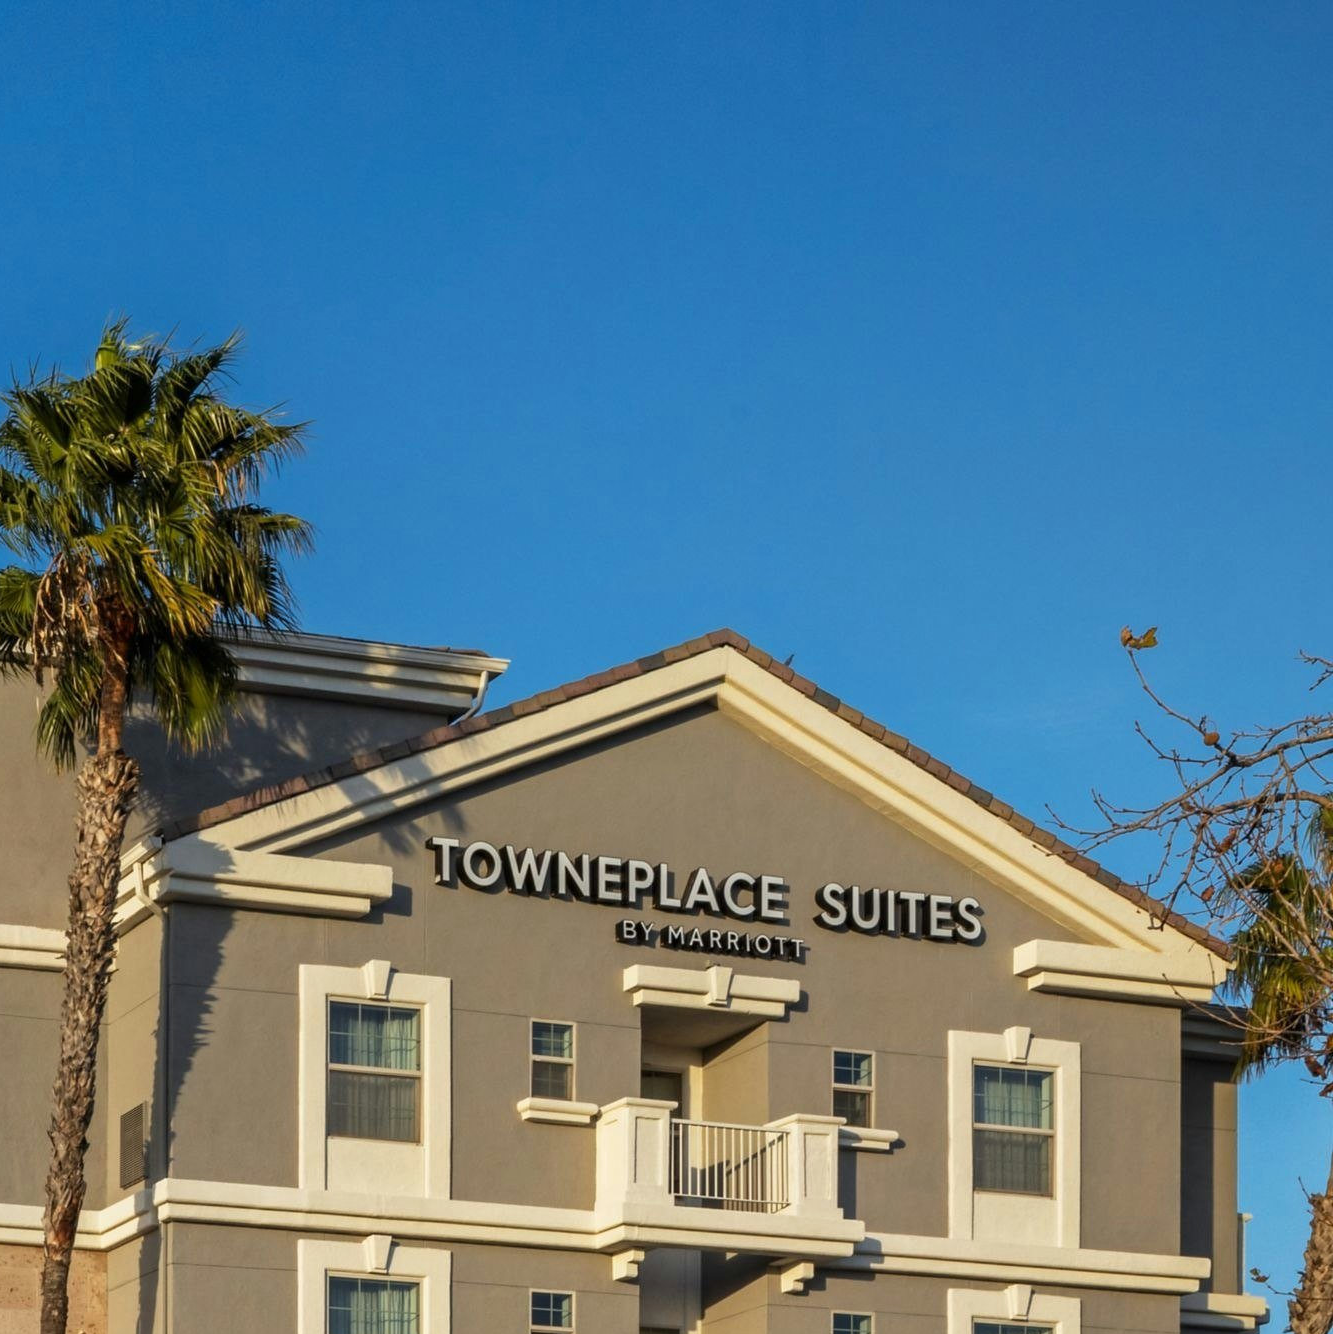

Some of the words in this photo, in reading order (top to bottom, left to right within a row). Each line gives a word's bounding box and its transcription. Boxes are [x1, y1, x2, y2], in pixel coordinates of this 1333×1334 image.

[432, 837, 785, 919] TOWNEPLACE
[820, 882, 982, 940] SUITES
[622, 919, 655, 941] BY
[667, 925, 805, 958] MARRIOTT
